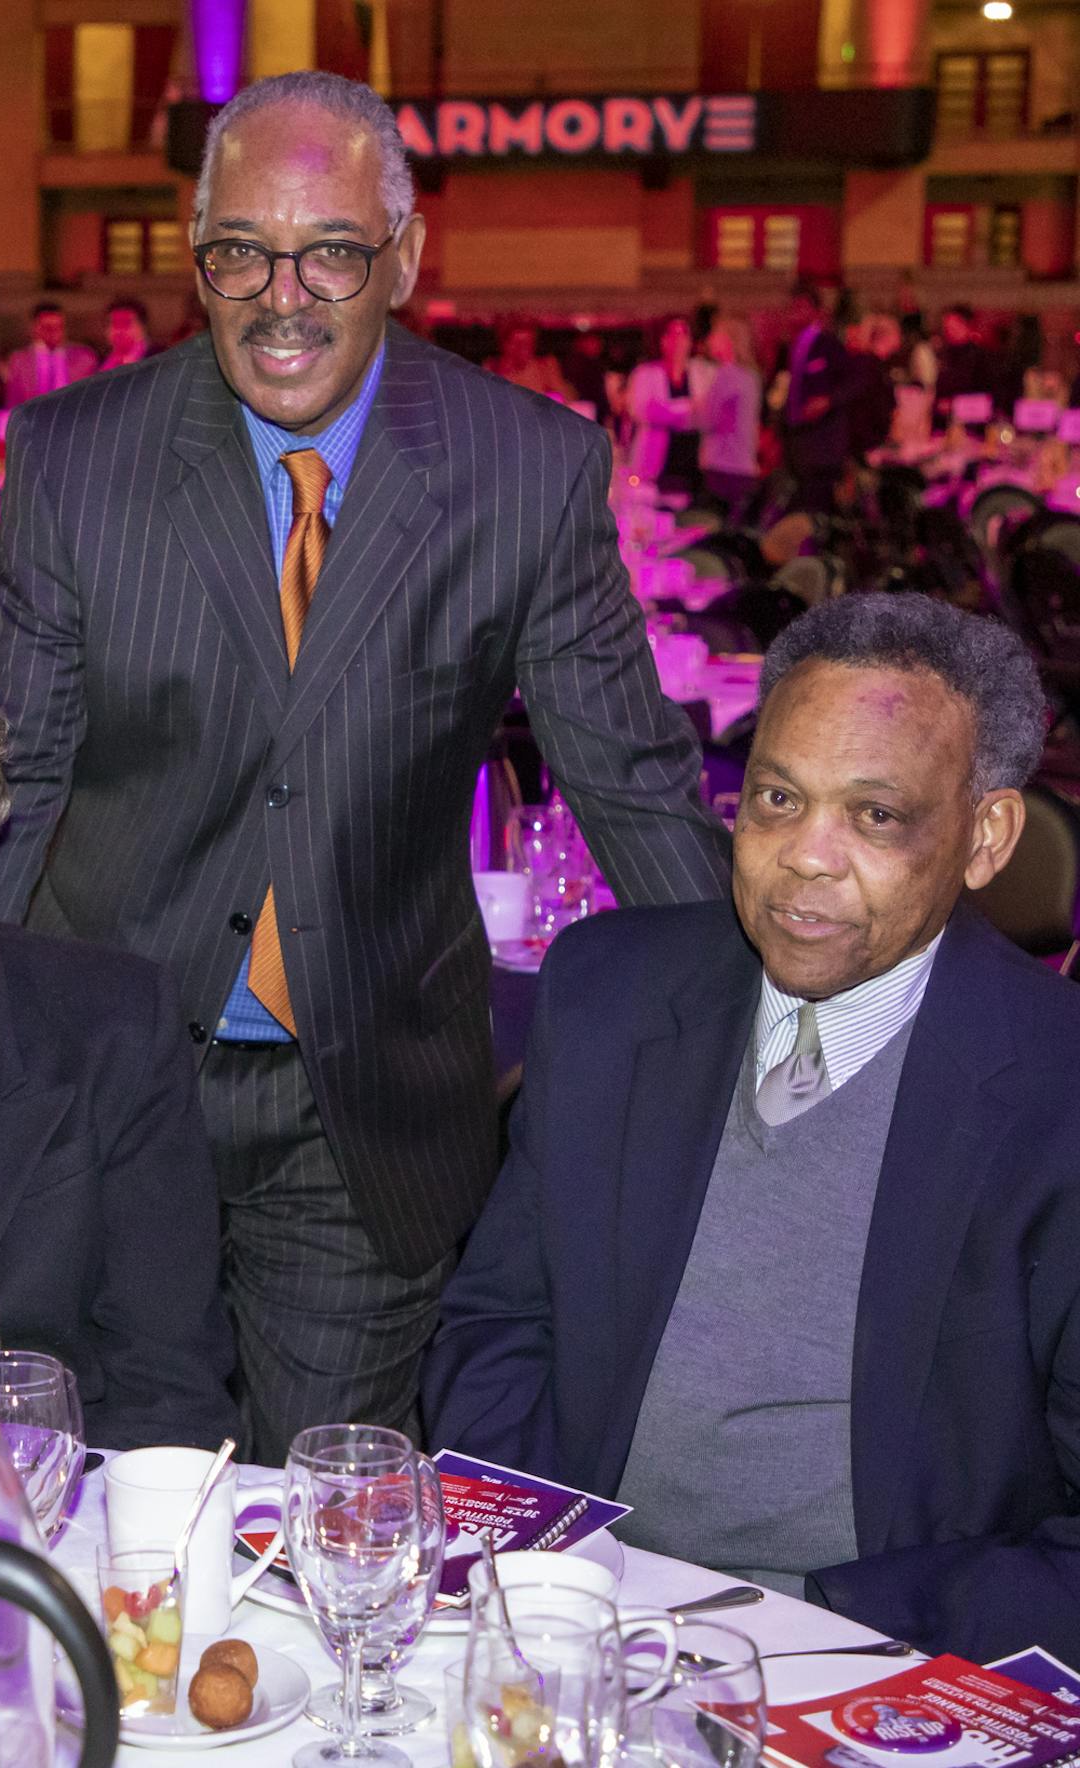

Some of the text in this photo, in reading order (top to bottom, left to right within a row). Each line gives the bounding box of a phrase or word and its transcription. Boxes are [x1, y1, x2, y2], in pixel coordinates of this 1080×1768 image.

[919, 1692, 976, 1718] CHANGE
[873, 1720, 923, 1742] RISE
[920, 1720, 946, 1735] UP
[975, 1714, 1039, 1744] POSITIVE
